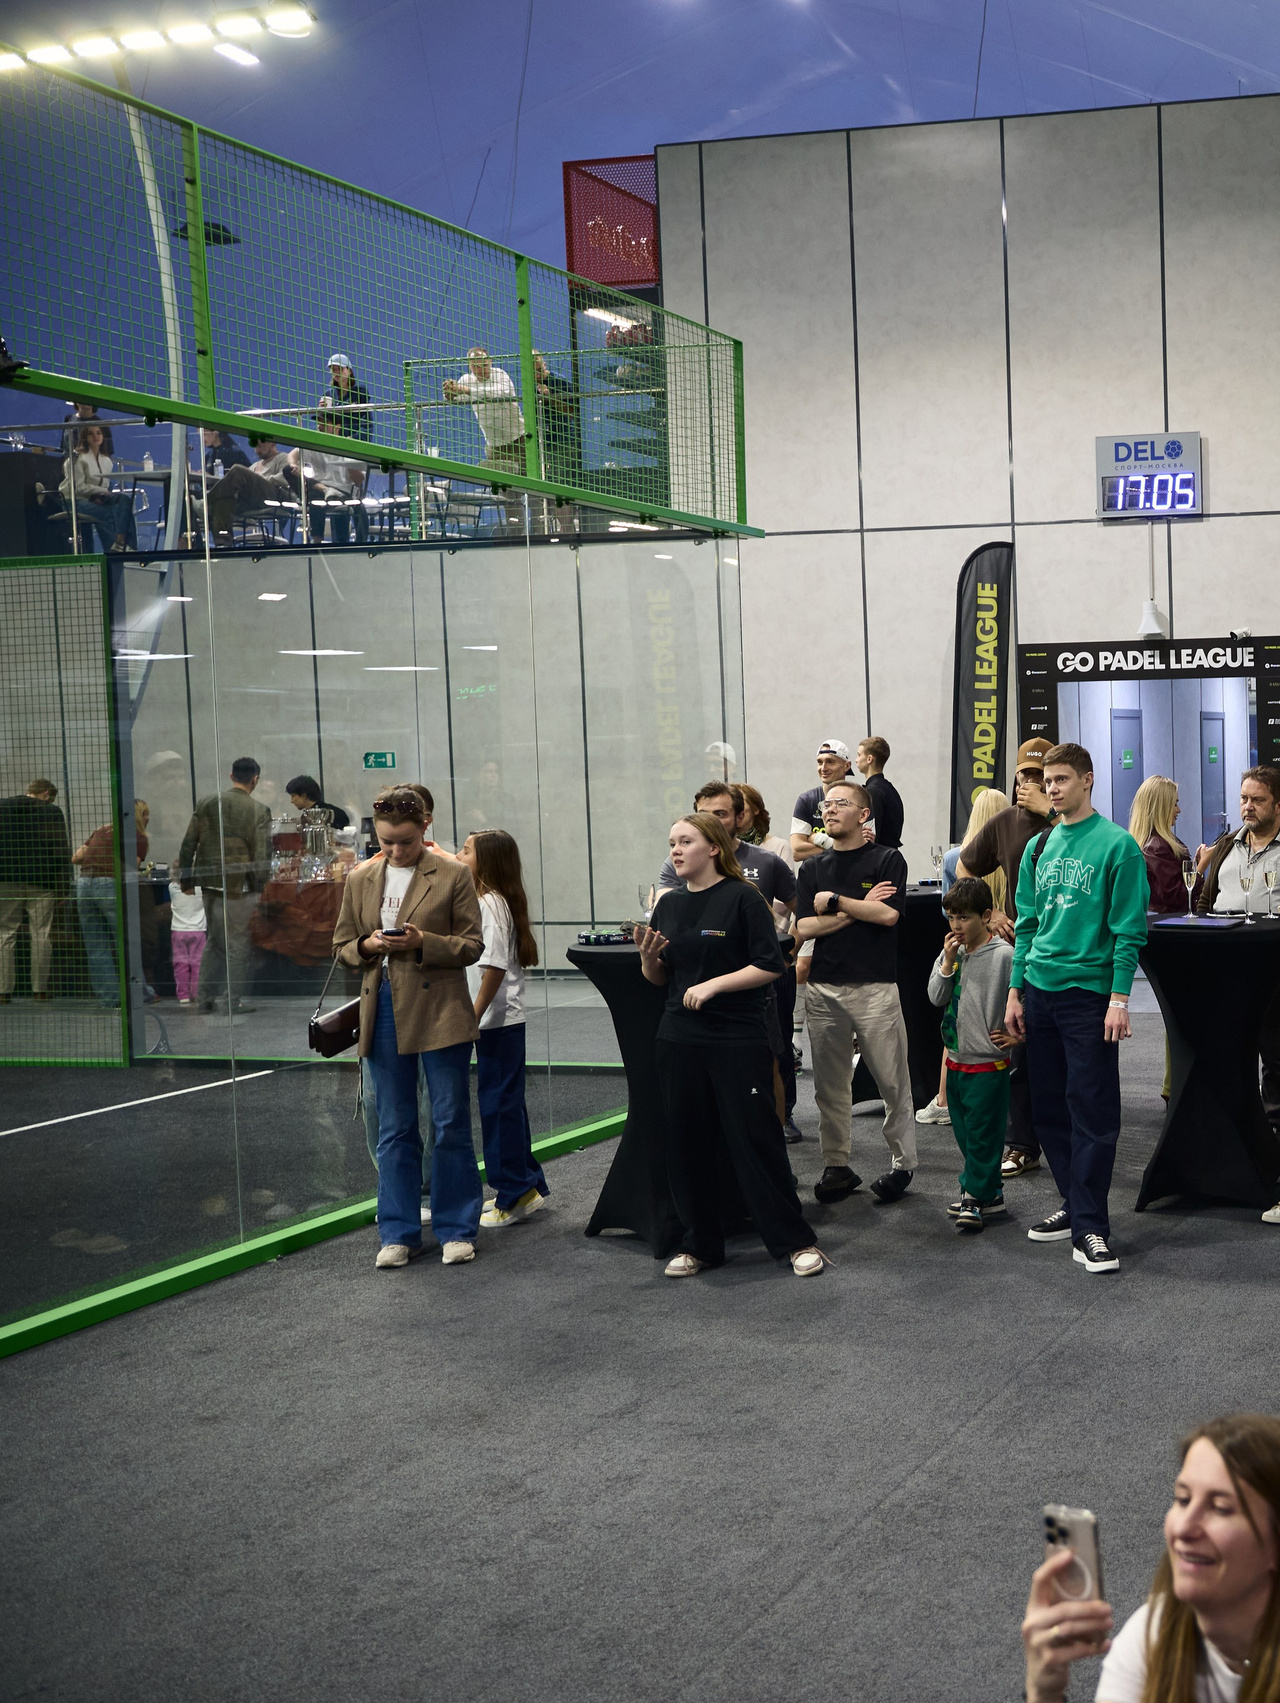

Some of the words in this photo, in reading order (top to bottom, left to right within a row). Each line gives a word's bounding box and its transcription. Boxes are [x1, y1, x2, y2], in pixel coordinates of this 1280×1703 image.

[974, 582, 998, 689] LEAGUE
[1057, 651, 1094, 673] GO
[1099, 649, 1166, 671] PADEL
[1170, 647, 1254, 670] LEAGUE
[973, 695, 997, 779] PADEL
[1035, 858, 1095, 895] MSGM
